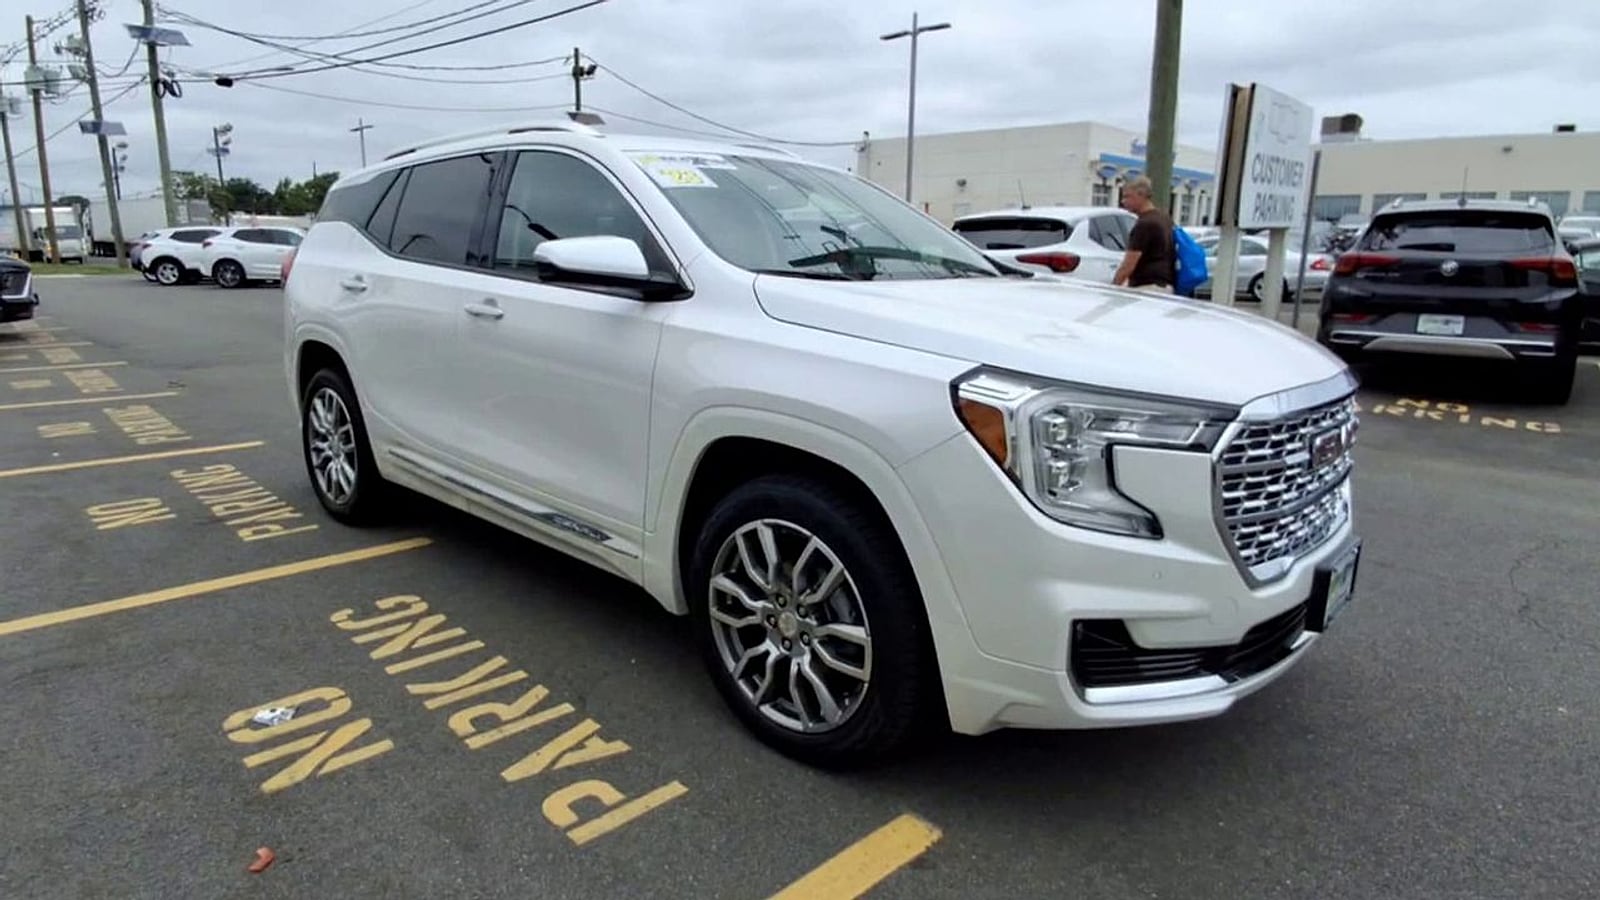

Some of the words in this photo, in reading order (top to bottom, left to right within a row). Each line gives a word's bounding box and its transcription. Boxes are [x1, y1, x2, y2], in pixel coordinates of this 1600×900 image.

[1251, 151, 1304, 187] CUSTOMER
[1251, 191, 1296, 221] PARKING
[1372, 404, 1562, 433] RKING
[1396, 398, 1470, 414] NO
[85, 497, 175, 531] NO
[170, 464, 318, 542] PARKING
[330, 595, 688, 846] PARKING
[223, 686, 394, 793] NO
